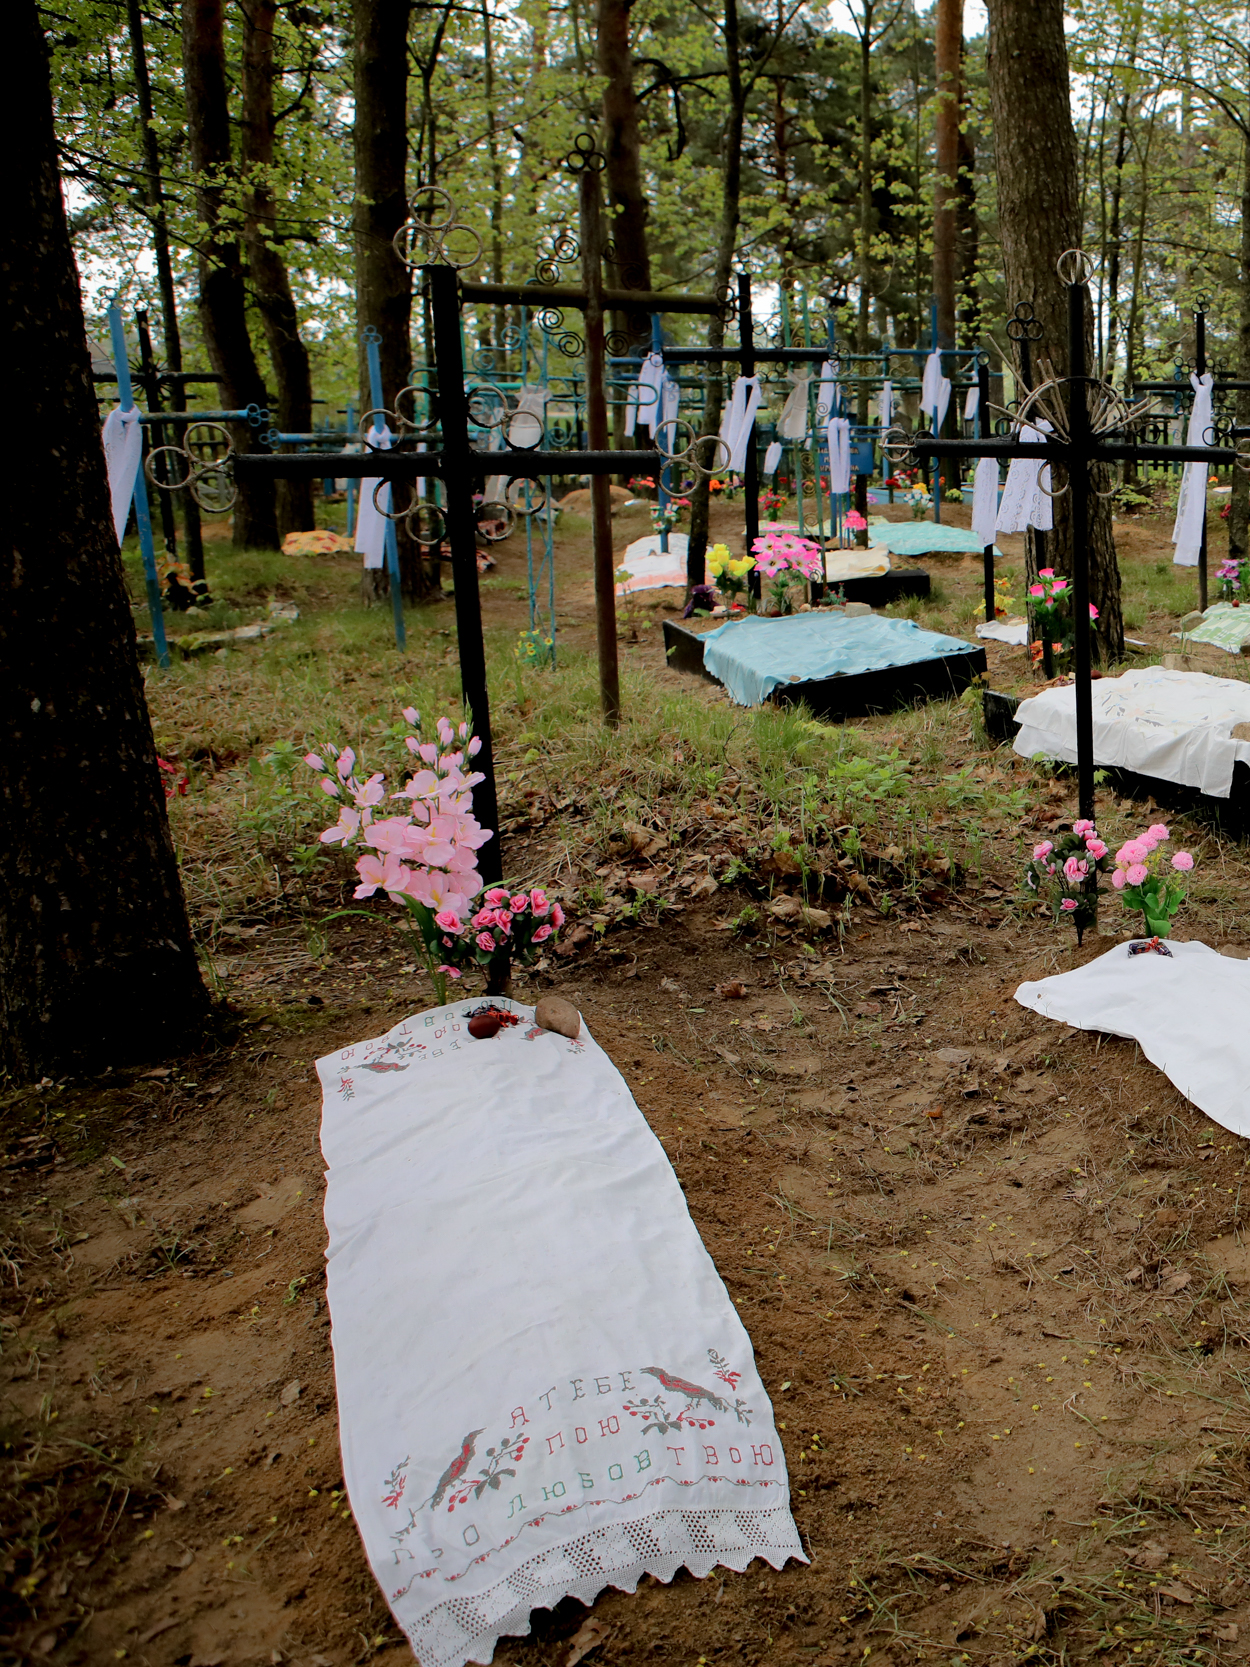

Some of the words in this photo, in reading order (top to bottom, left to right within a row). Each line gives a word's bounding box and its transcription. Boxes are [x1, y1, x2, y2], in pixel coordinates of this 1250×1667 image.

[538, 1371, 636, 1411] ТЕБЕ
[545, 1415, 620, 1455] ПОЮ
[507, 1449, 652, 1519] ЛЮБОВ
[666, 1443, 775, 1467] ТВОЮ
